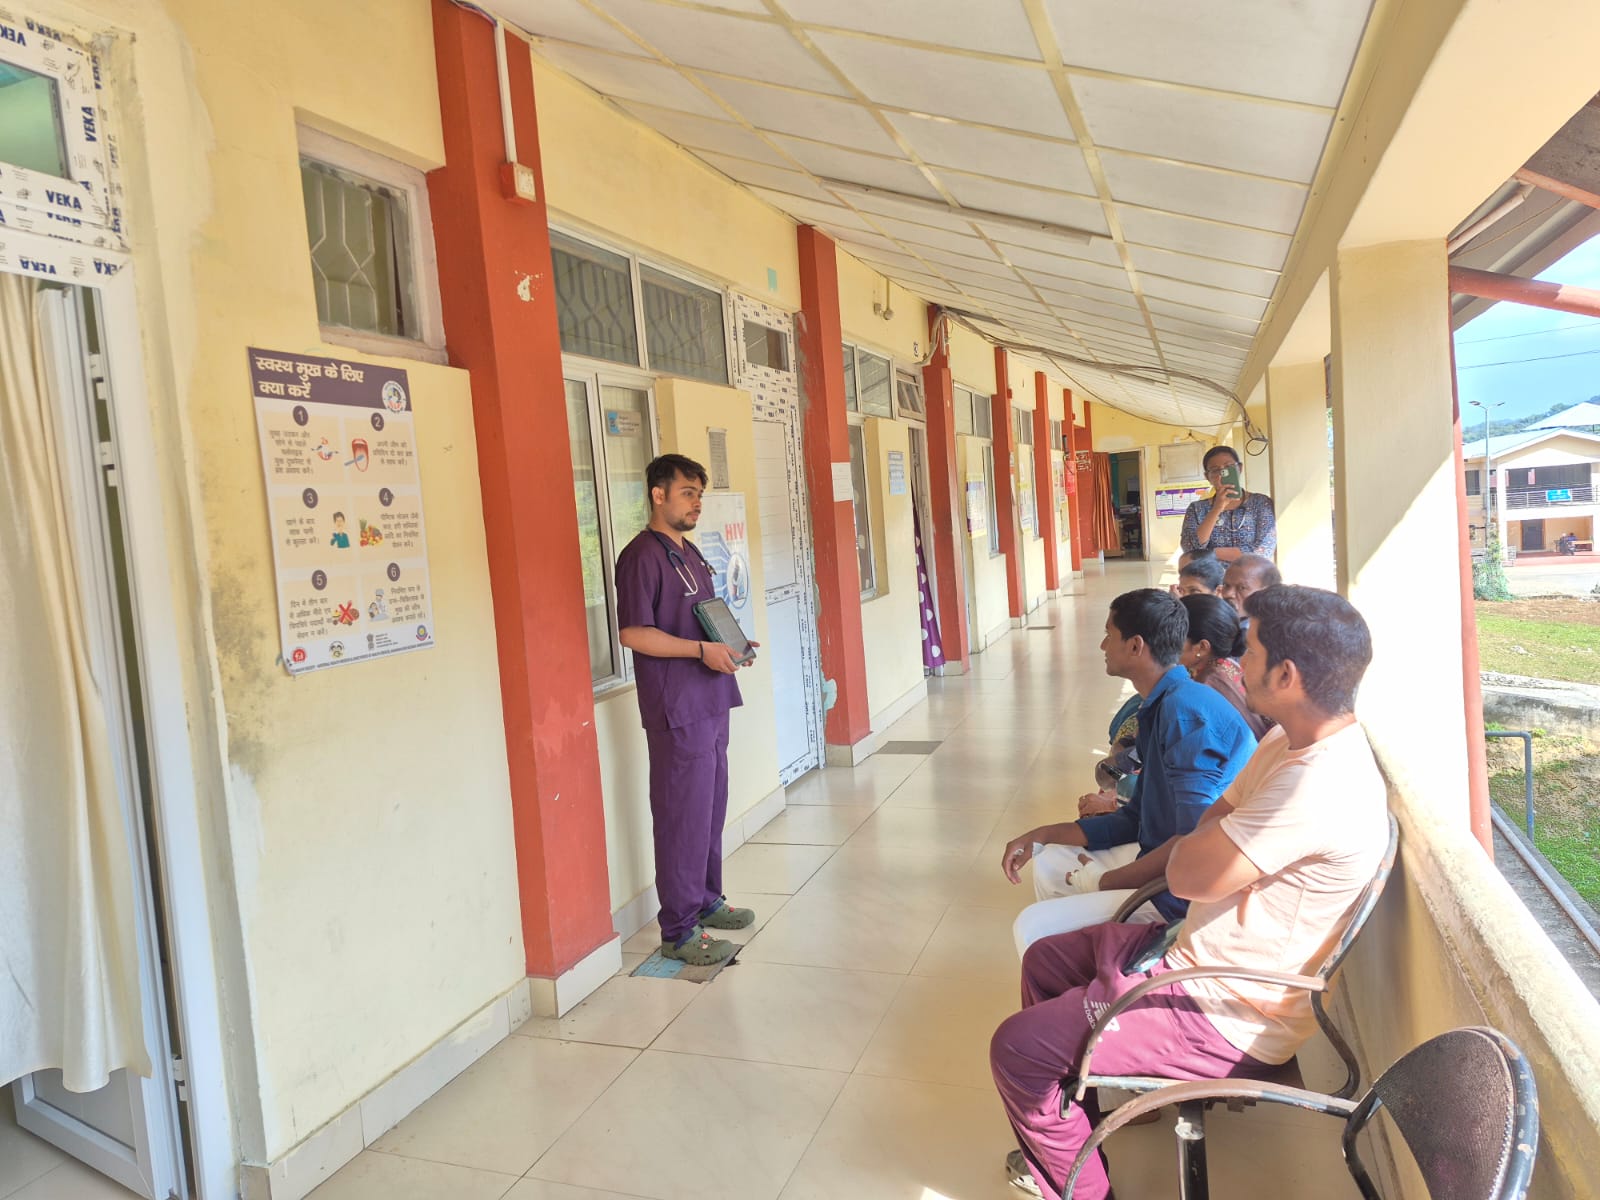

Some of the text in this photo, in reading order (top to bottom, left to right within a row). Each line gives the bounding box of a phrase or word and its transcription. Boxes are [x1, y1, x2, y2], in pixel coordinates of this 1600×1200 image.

[81, 106, 98, 142] VEKA
[45, 189, 83, 211] VEKA
[19, 258, 57, 275] VEKA
[93, 260, 123, 276] EKA
[255, 356, 364, 383] स्वस्थ मुख के लिए
[258, 380, 312, 398] क्या करें
[725, 522, 744, 541] HIV
